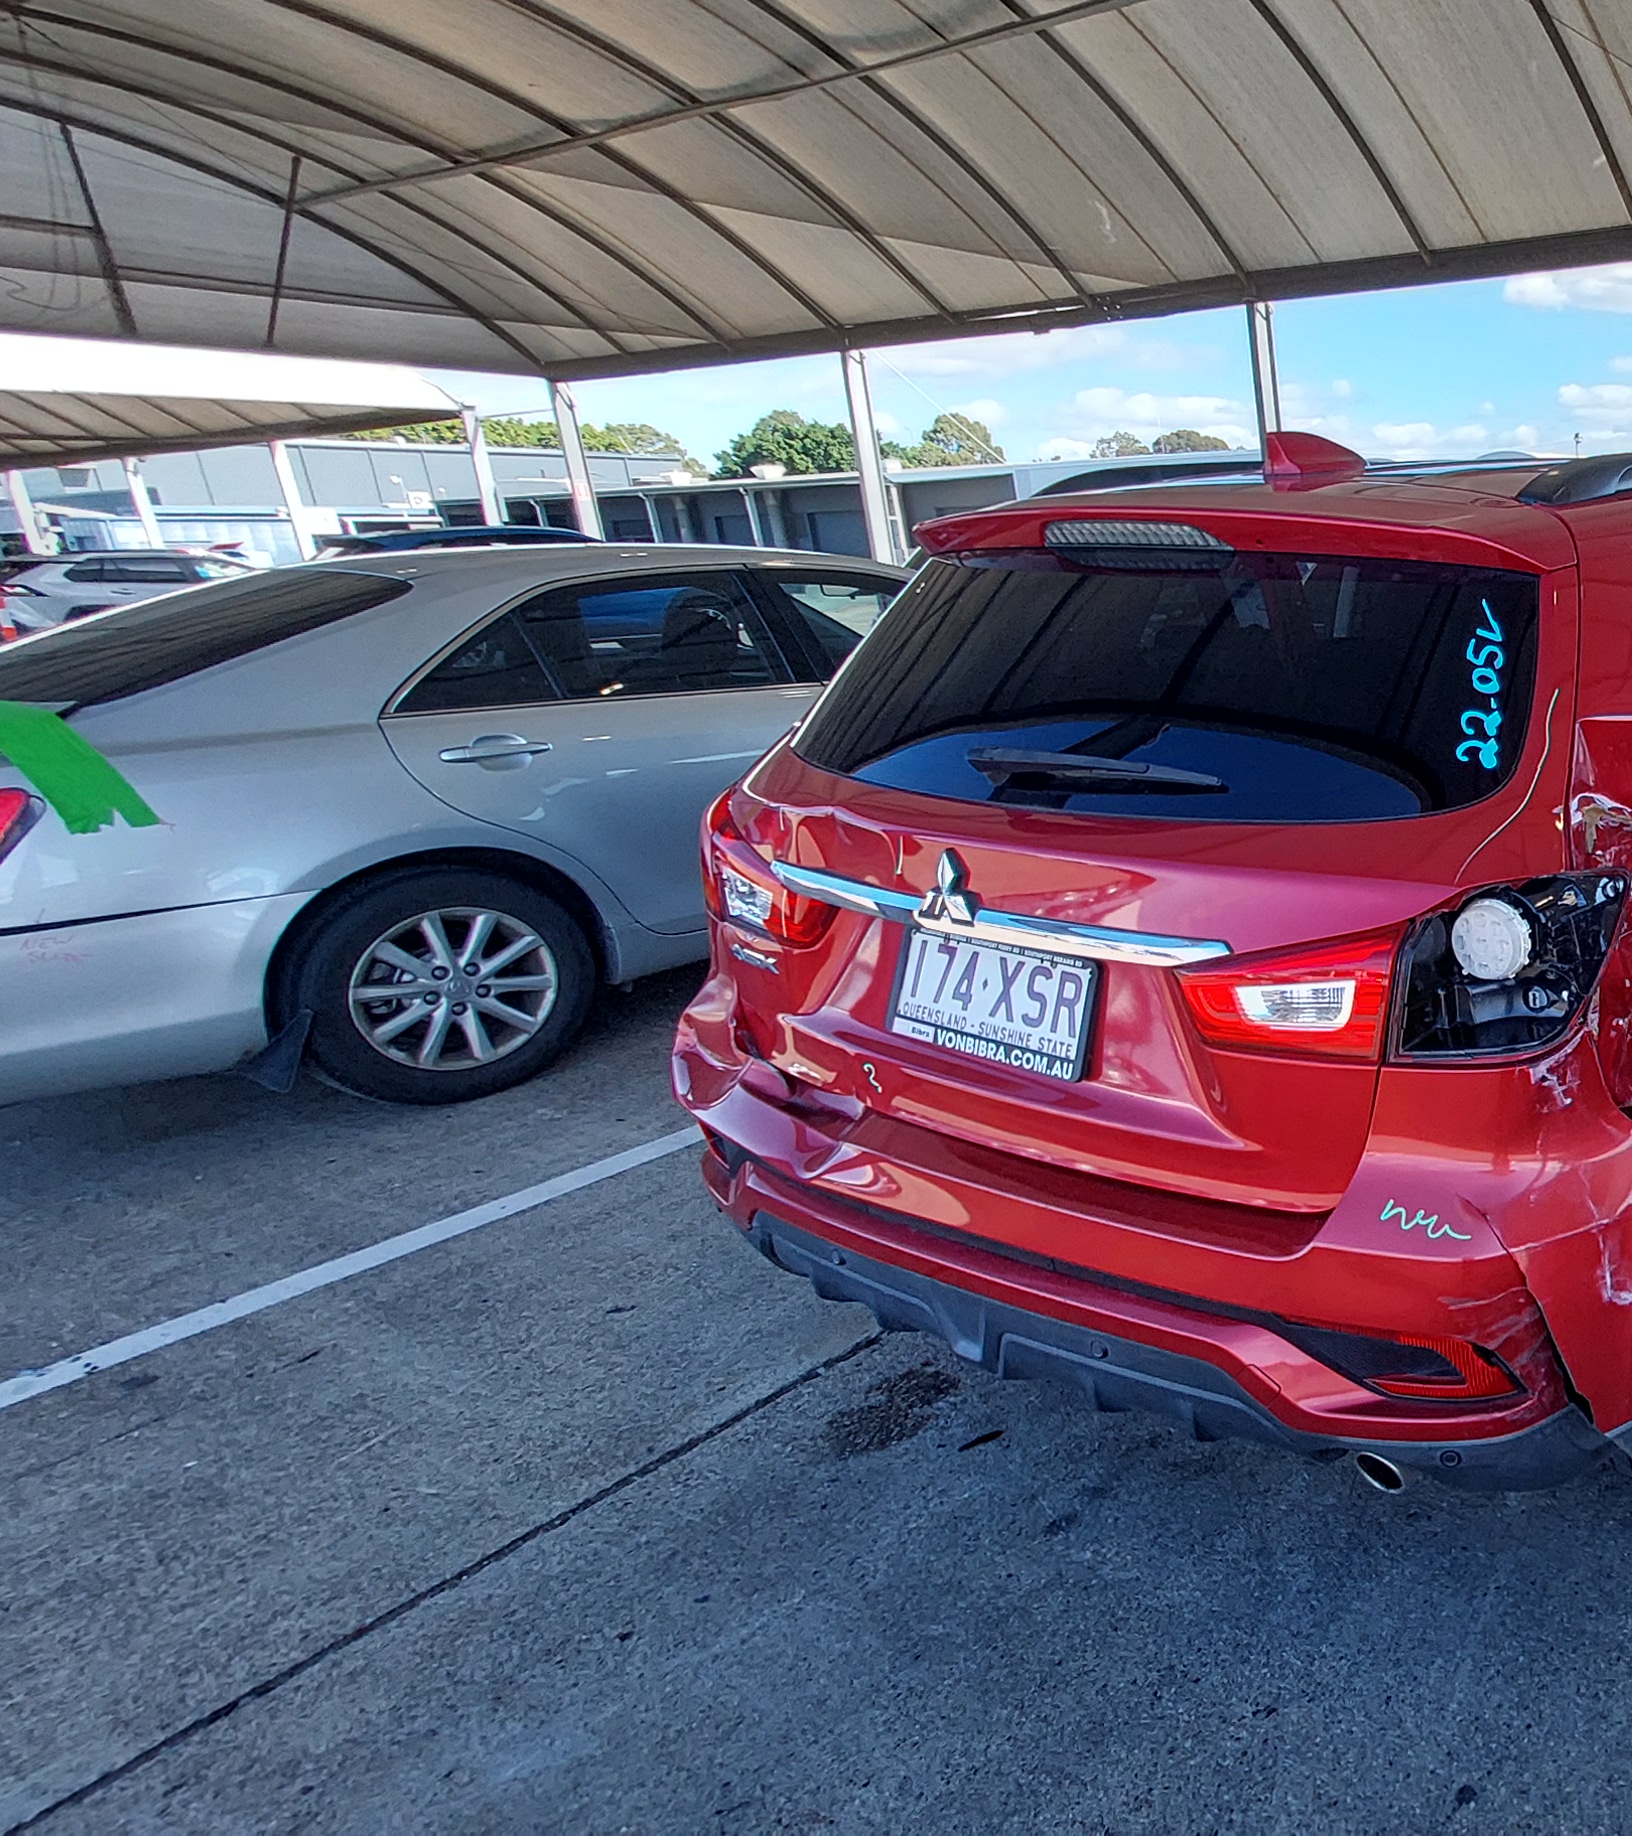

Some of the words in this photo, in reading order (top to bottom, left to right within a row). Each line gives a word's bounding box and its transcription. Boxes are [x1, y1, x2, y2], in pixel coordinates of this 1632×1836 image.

[903, 1001, 967, 1030] QUEENSLAND
[978, 1021, 1033, 1048] SUNSHINE
[1037, 1036, 1073, 1059] STATE
[937, 1028, 1074, 1080] VONBIBRA.COM.AU
